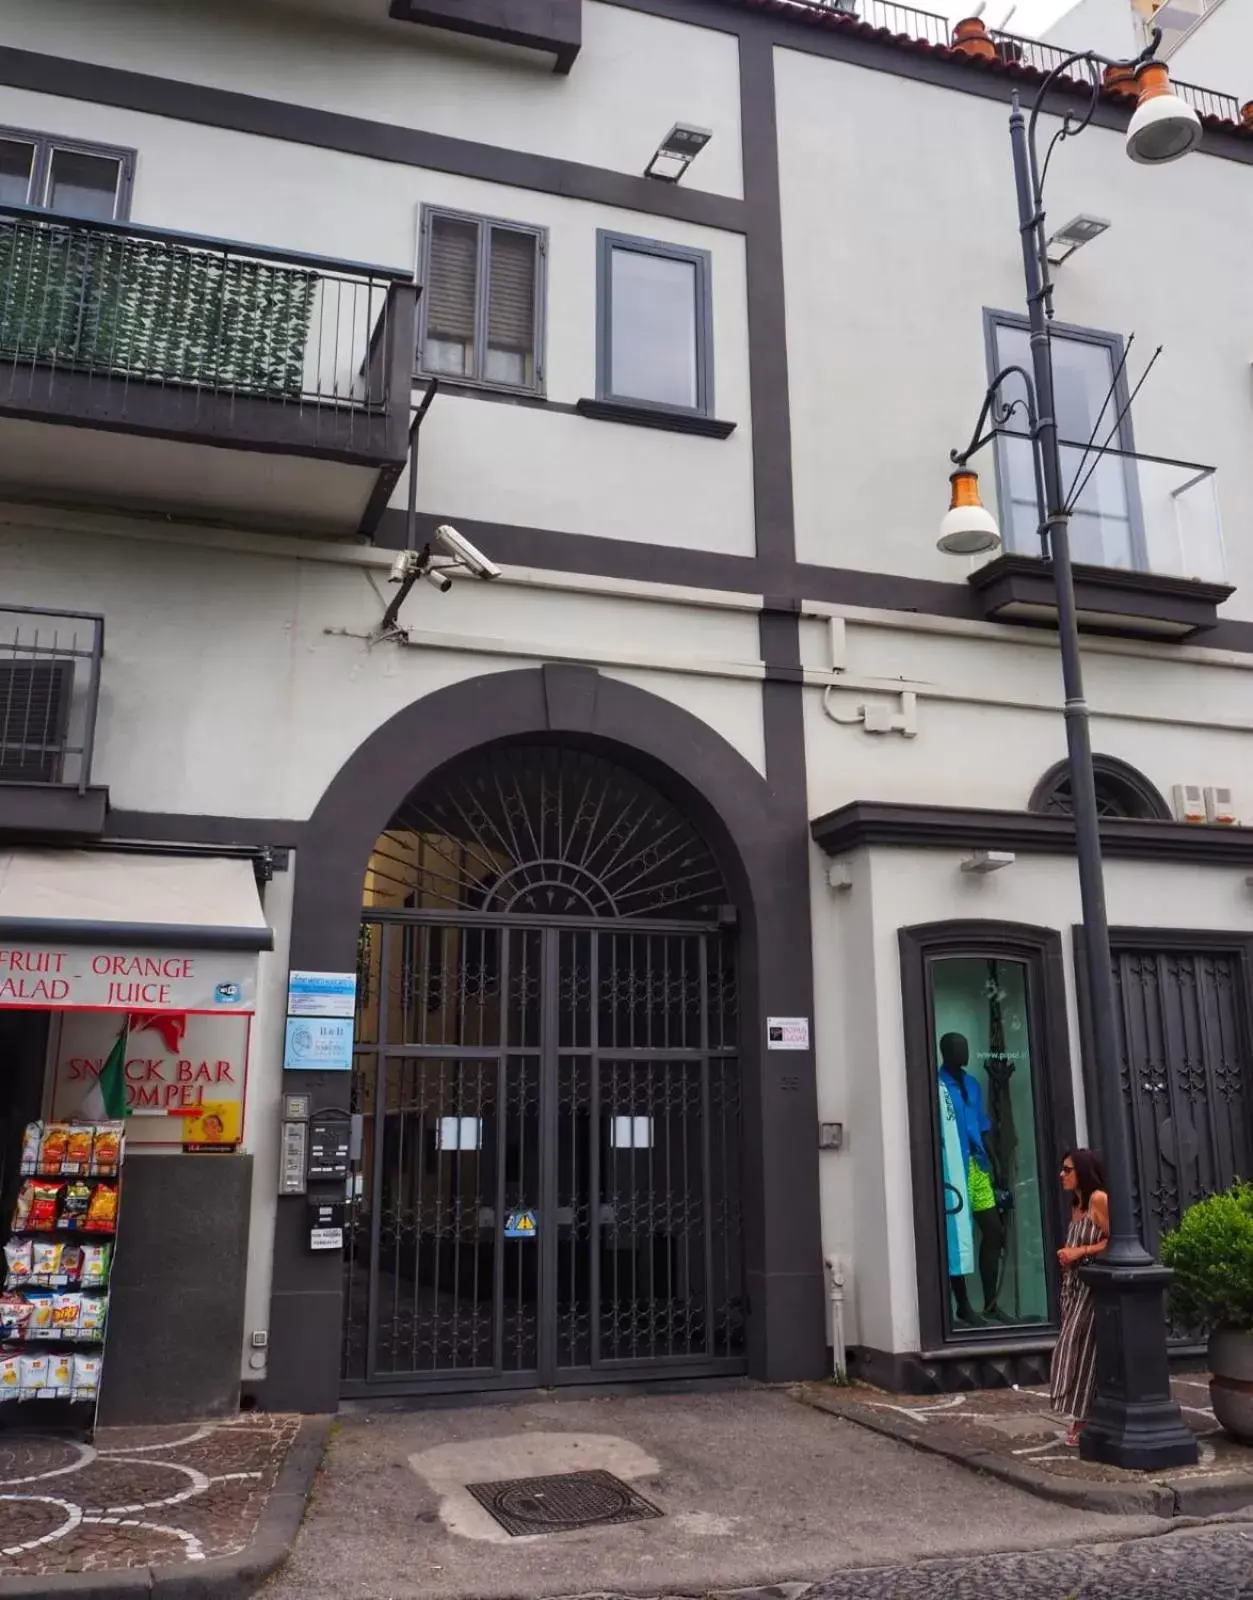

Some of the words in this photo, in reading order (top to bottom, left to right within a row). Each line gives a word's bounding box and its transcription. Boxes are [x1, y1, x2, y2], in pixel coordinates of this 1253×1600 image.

[92, 955, 195, 979] ORANGE
[0, 978, 69, 1000] ALAD
[107, 981, 171, 1004] JUICE
[68, 1058, 165, 1082] SNCK
[176, 1060, 236, 1083] BAR
